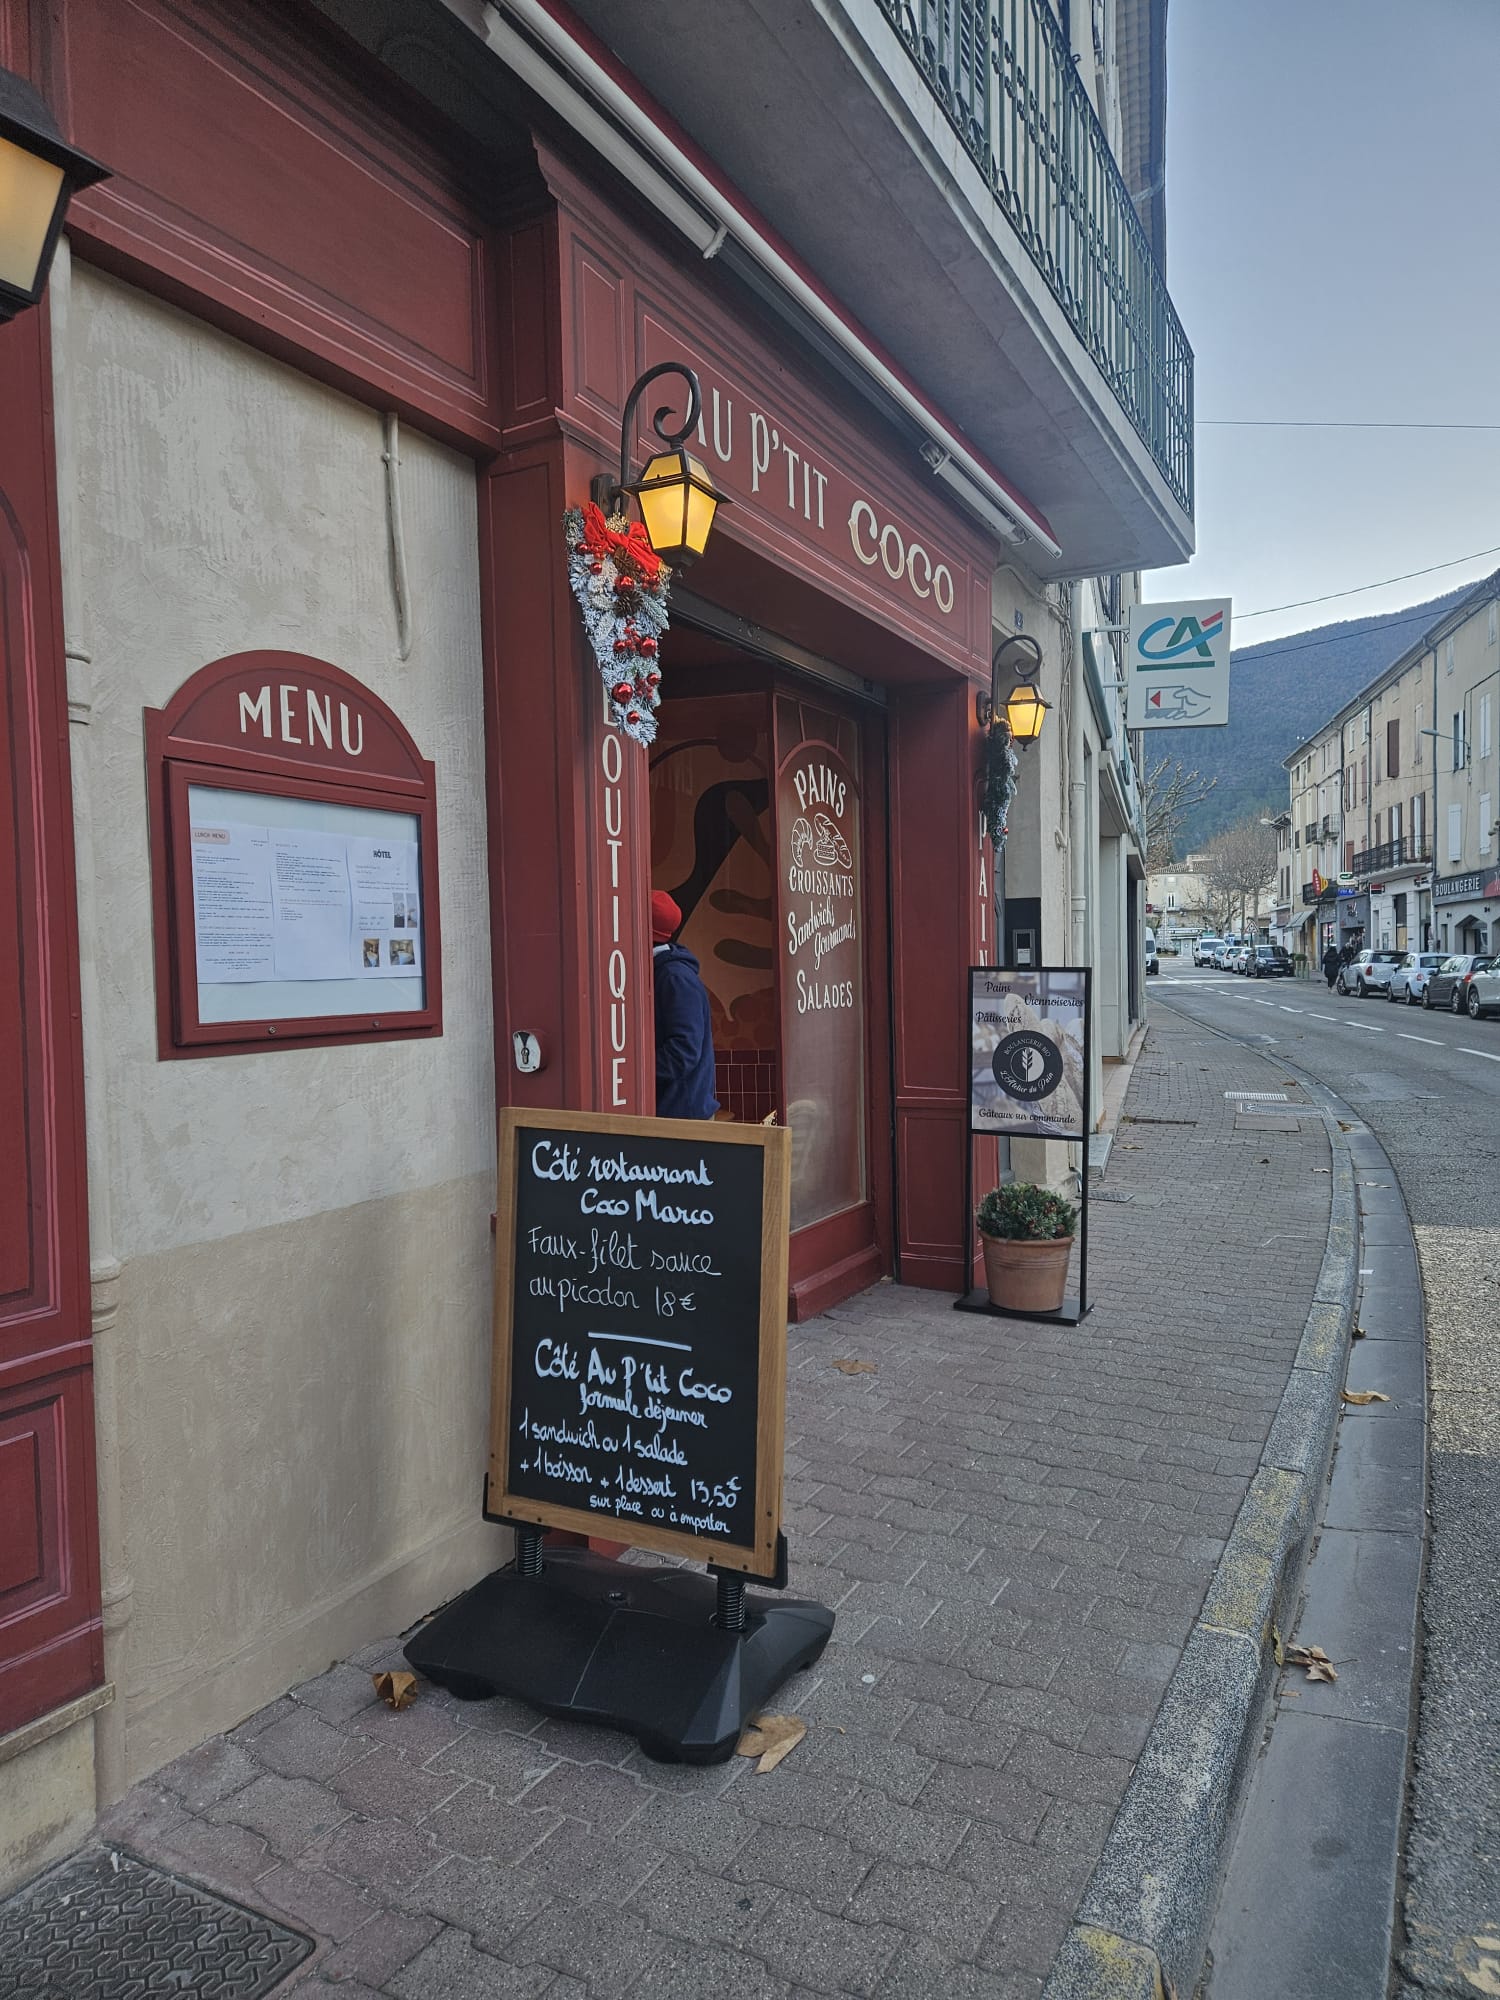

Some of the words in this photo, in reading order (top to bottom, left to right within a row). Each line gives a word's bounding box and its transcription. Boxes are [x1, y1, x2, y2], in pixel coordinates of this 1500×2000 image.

[750, 412, 828, 530] P'TIT
[848, 500, 954, 613] COCO
[1137, 610, 1223, 660] CA
[238, 685, 364, 757] MENU
[794, 763, 846, 818] PAINS
[373, 849, 392, 859] HÔTEL
[788, 865, 854, 898] CROISSANTS
[1435, 877, 1480, 897] BOULANGERIE
[788, 896, 835, 955] Sandwichs
[796, 969, 853, 1014] SALADES
[985, 981, 1011, 993] Pains
[1024, 993, 1084, 1008] Viennoiseries
[976, 1011, 1022, 1024] Pâtisseries
[1003, 1038, 1042, 1055] BOULANGERIE
[1042, 1046, 1051, 1057] BIO
[1000, 1070, 1027, 1093] L'Atelier
[1038, 1072, 1054, 1091] Pain
[979, 1108, 1014, 1119] Gâteaux
[1015, 1112, 1026, 1121] sur
[1030, 1113, 1076, 1124] commande
[531, 1140, 581, 1181] Côté
[587, 1151, 714, 1185] restaurant
[580, 1188, 629, 1215] Coco
[635, 1188, 714, 1225] Marco
[528, 1226, 641, 1274] Faux-filet
[650, 1250, 722, 1275] sauce
[655, 1286, 696, 1316] 18€
[534, 1338, 580, 1380] Côté
[587, 1348, 617, 1385] Au
[622, 1356, 671, 1394] P'tit
[679, 1368, 732, 1403] Coco
[579, 1383, 642, 1419] formule
[644, 1397, 708, 1433] déjeuner
[531, 1419, 600, 1449] sandwich
[602, 1437, 619, 1453] ou
[634, 1433, 688, 1466] salade
[545, 1453, 592, 1483] boisson
[626, 1468, 676, 1497] dessert
[589, 1495, 611, 1508] sur
[615, 1497, 643, 1516] place
[651, 1507, 664, 1518] ou
[669, 1505, 678, 1522] à
